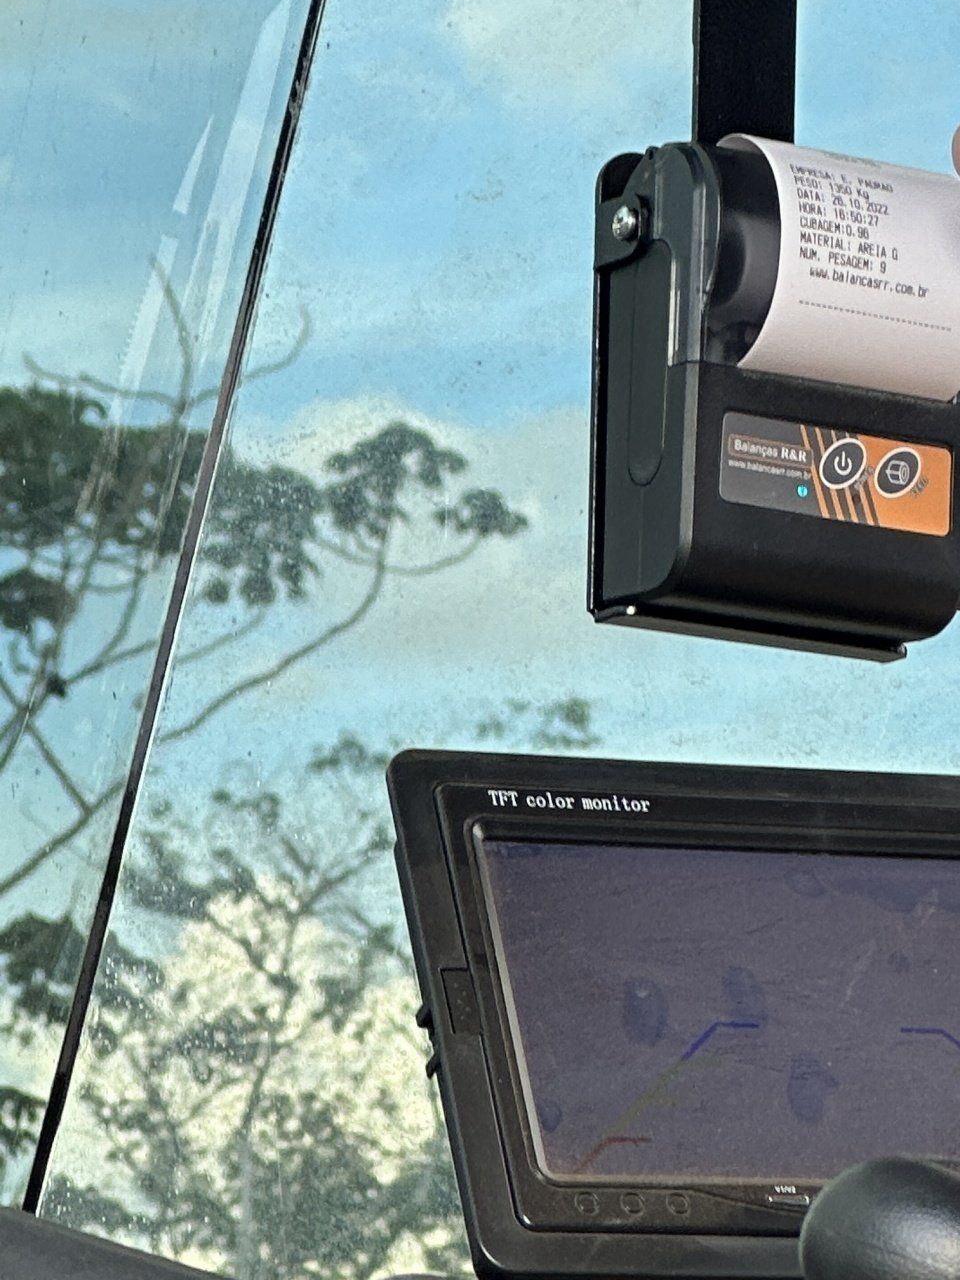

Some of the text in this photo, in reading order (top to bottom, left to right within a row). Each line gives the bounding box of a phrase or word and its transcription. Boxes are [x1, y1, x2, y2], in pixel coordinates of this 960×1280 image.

[796, 188, 825, 203] DATA:
[798, 201, 827, 217] HORA:
[800, 231, 851, 251] MATERIAL:
[858, 241, 887, 259] AREIA
[799, 246, 887, 274] NUM. PESAGEM: 9
[809, 267, 929, 298] www.balancasrr.com.br
[734, 439, 807, 463] Balanças R&R
[487, 789, 651, 813] TFT color monitor
